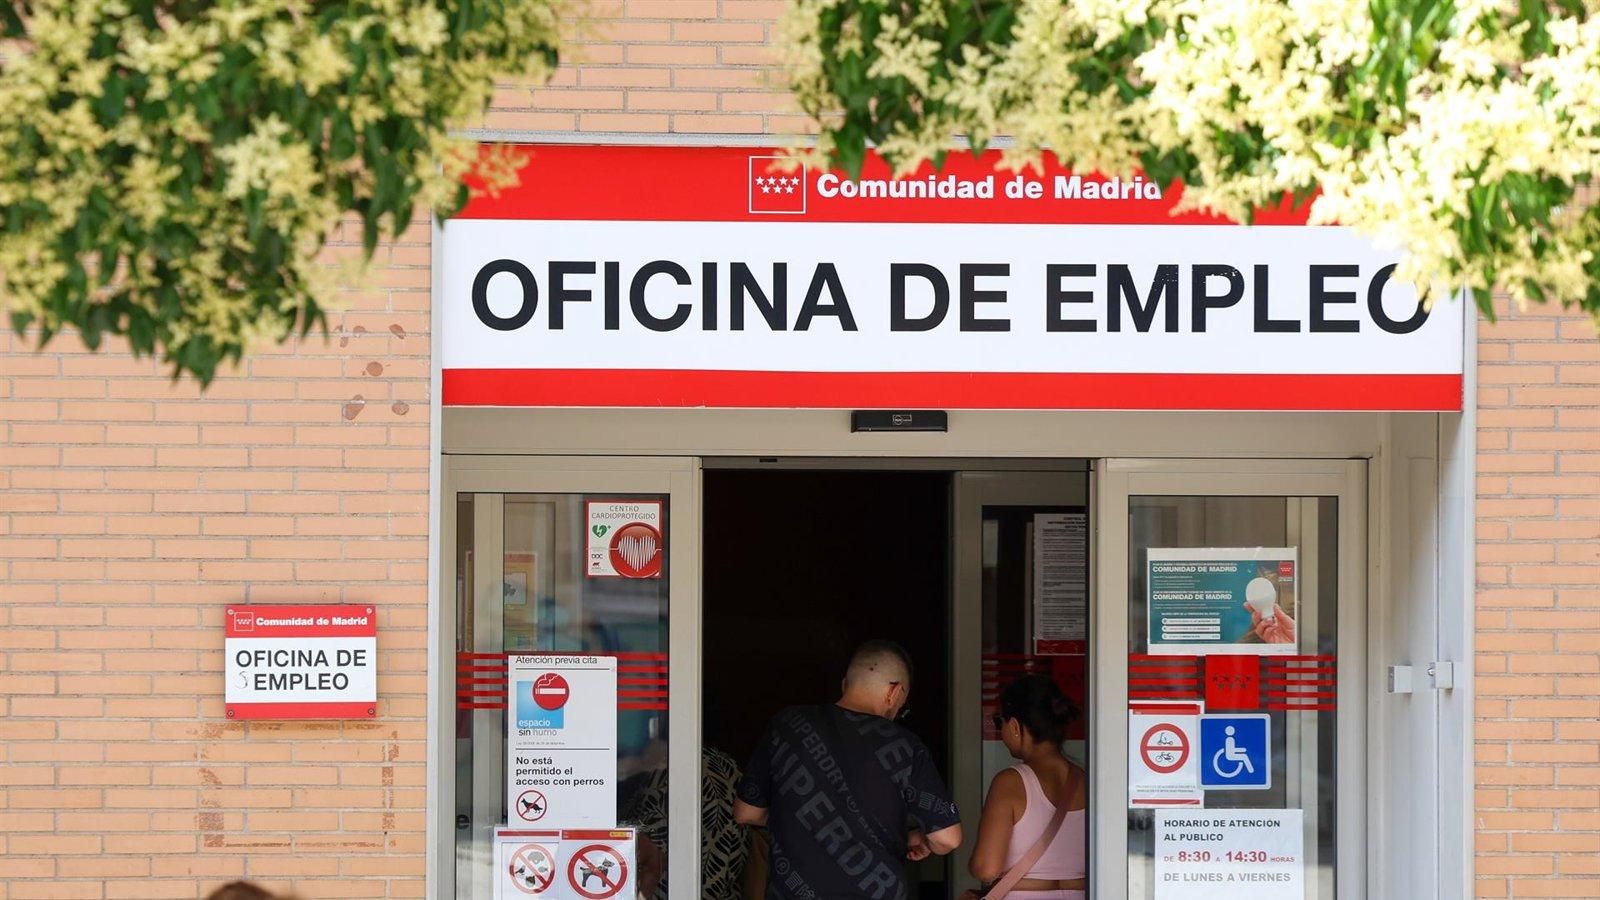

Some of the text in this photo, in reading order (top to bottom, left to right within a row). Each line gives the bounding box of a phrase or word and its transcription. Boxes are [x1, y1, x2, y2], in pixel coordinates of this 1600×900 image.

[817, 173, 994, 199] Comunidad
[1005, 175, 1043, 200] de
[471, 258, 1433, 335] OFICINA DE EMPLEO
[591, 512, 656, 520] CARDIOPROTEGIDO
[256, 616, 368, 626] Comunidad de Madrid
[235, 649, 367, 668] OFICINA DE
[515, 655, 598, 666] Atención previa cita
[254, 672, 349, 691] EMPLEO
[518, 719, 551, 728] espacio
[518, 728, 558, 736] sin humo
[784, 706, 849, 793] UPERDRY
[515, 756, 553, 765] No está
[515, 767, 573, 777] permitido el
[515, 778, 605, 787] acceso con perros
[1164, 818, 1281, 828] HORARIO DE ATENCIÓN
[1178, 851, 1211, 862] 8:30
[1225, 851, 1267, 862] 14:30
[1164, 873, 1291, 882] DE LUNES A VIERNES
